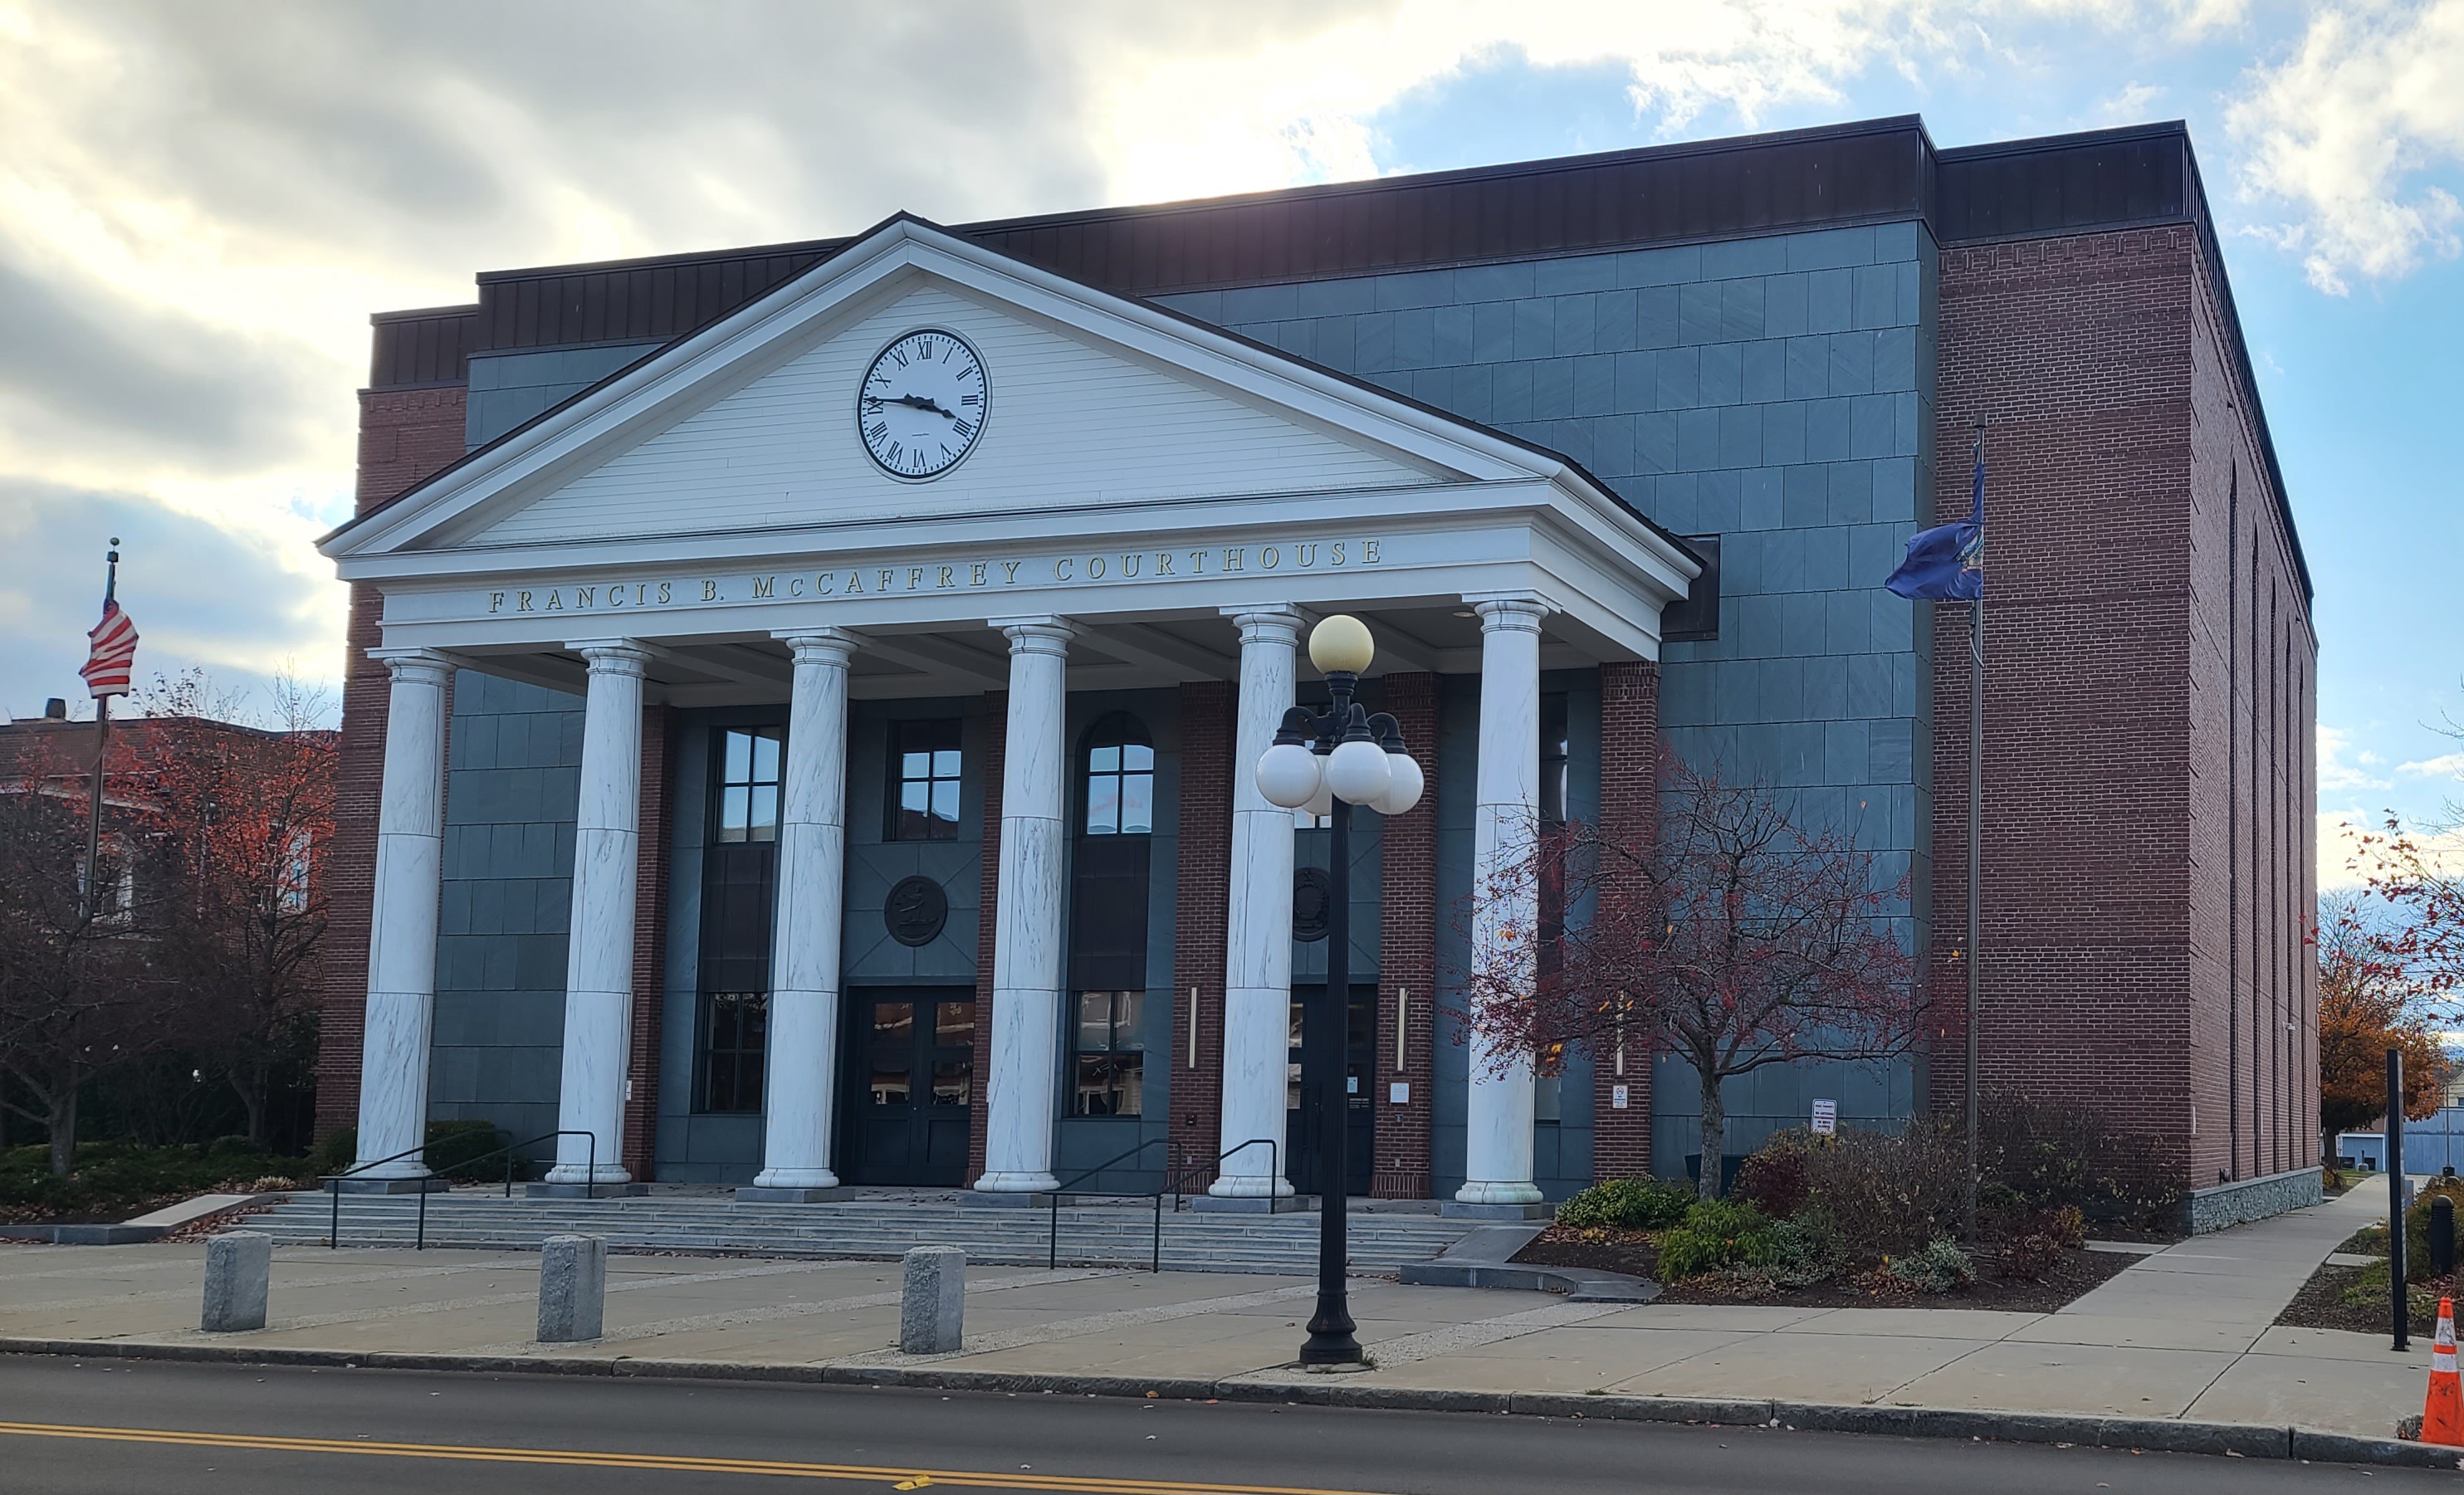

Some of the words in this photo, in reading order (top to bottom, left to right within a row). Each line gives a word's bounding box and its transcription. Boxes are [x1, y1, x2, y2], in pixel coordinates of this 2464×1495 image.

[917, 341, 932, 360] XII
[942, 347, 953, 364] I
[892, 349, 909, 371] XI
[874, 374, 892, 388] X
[956, 366, 974, 381] II
[962, 394, 978, 406] III
[870, 421, 888, 447] VIII
[952, 418, 972, 437] IIII
[887, 441, 903, 464] VII
[913, 449, 926, 467] VI
[940, 442, 951, 459] V
[489, 583, 671, 613] FRANCIS
[701, 580, 725, 601] B.
[1054, 540, 1381, 581] COURTHOUSE
